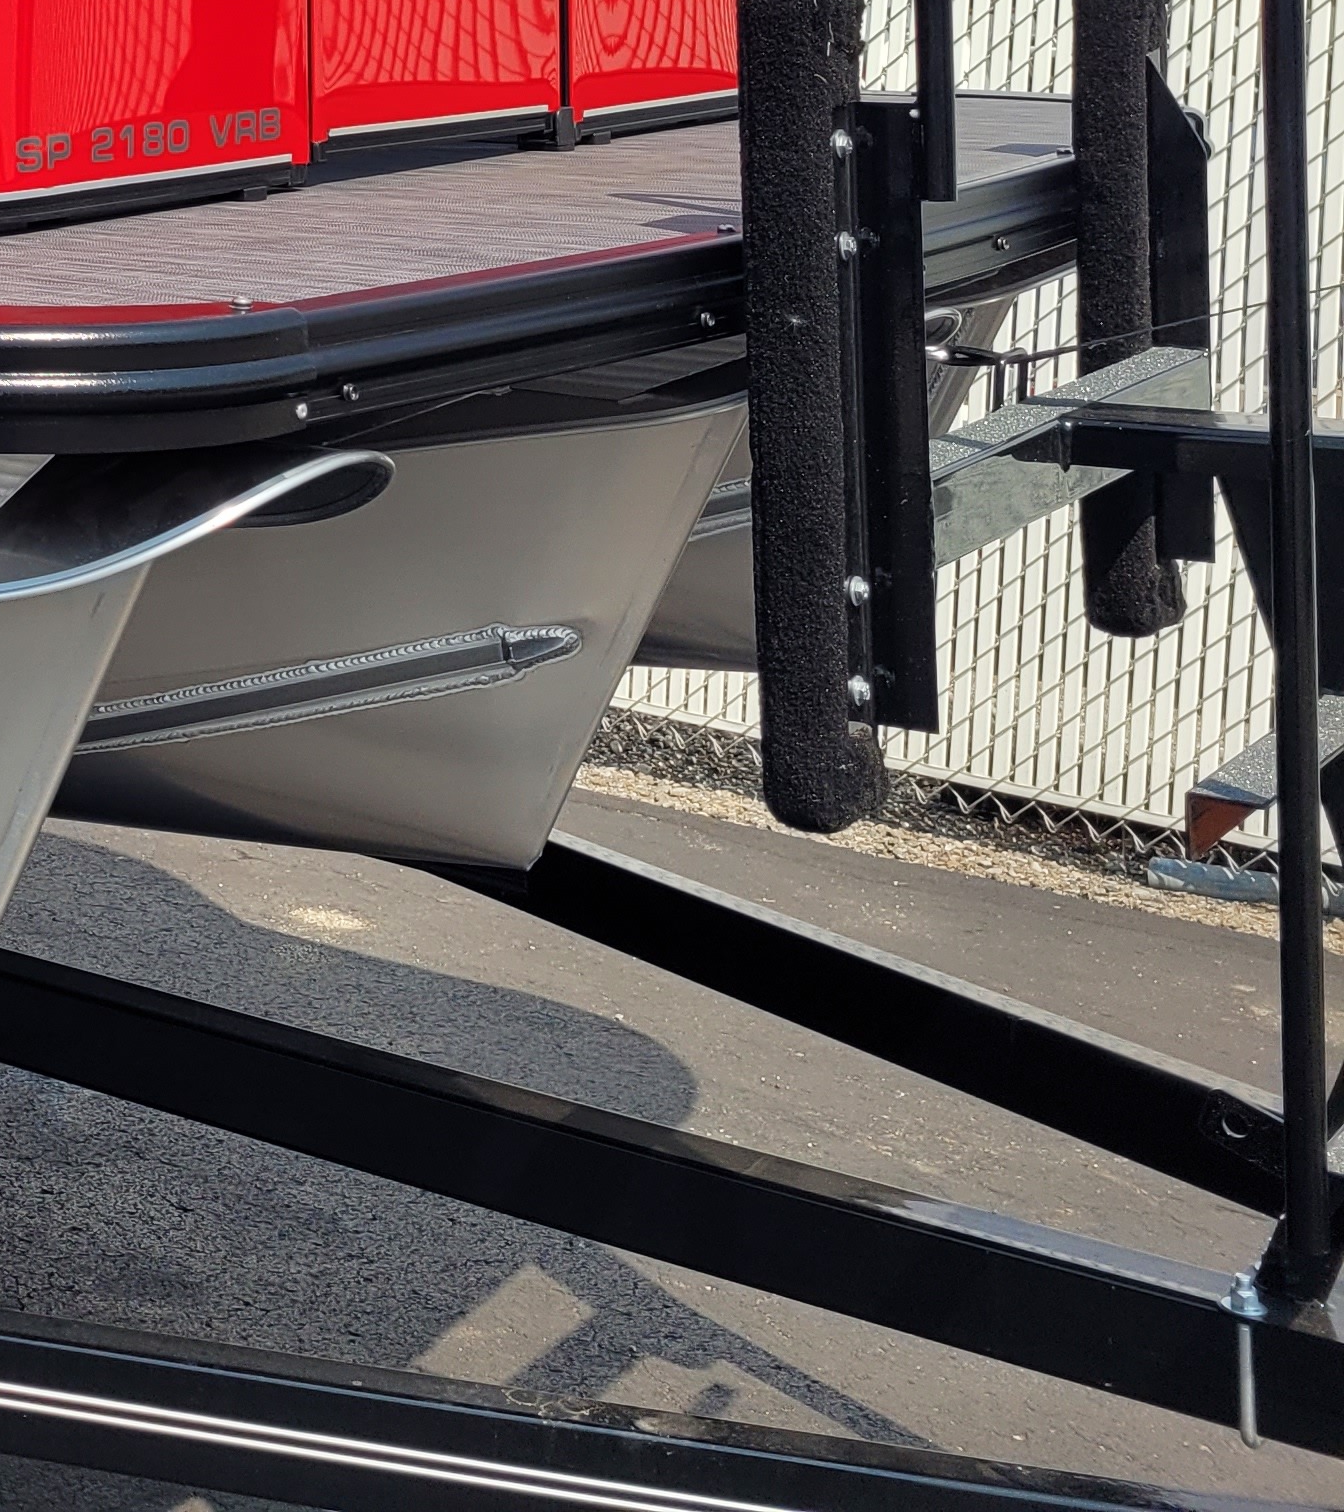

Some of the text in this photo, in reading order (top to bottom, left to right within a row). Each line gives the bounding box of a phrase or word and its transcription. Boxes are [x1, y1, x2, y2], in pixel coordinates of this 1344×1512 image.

[15, 107, 281, 172] SP 2180 VRB
